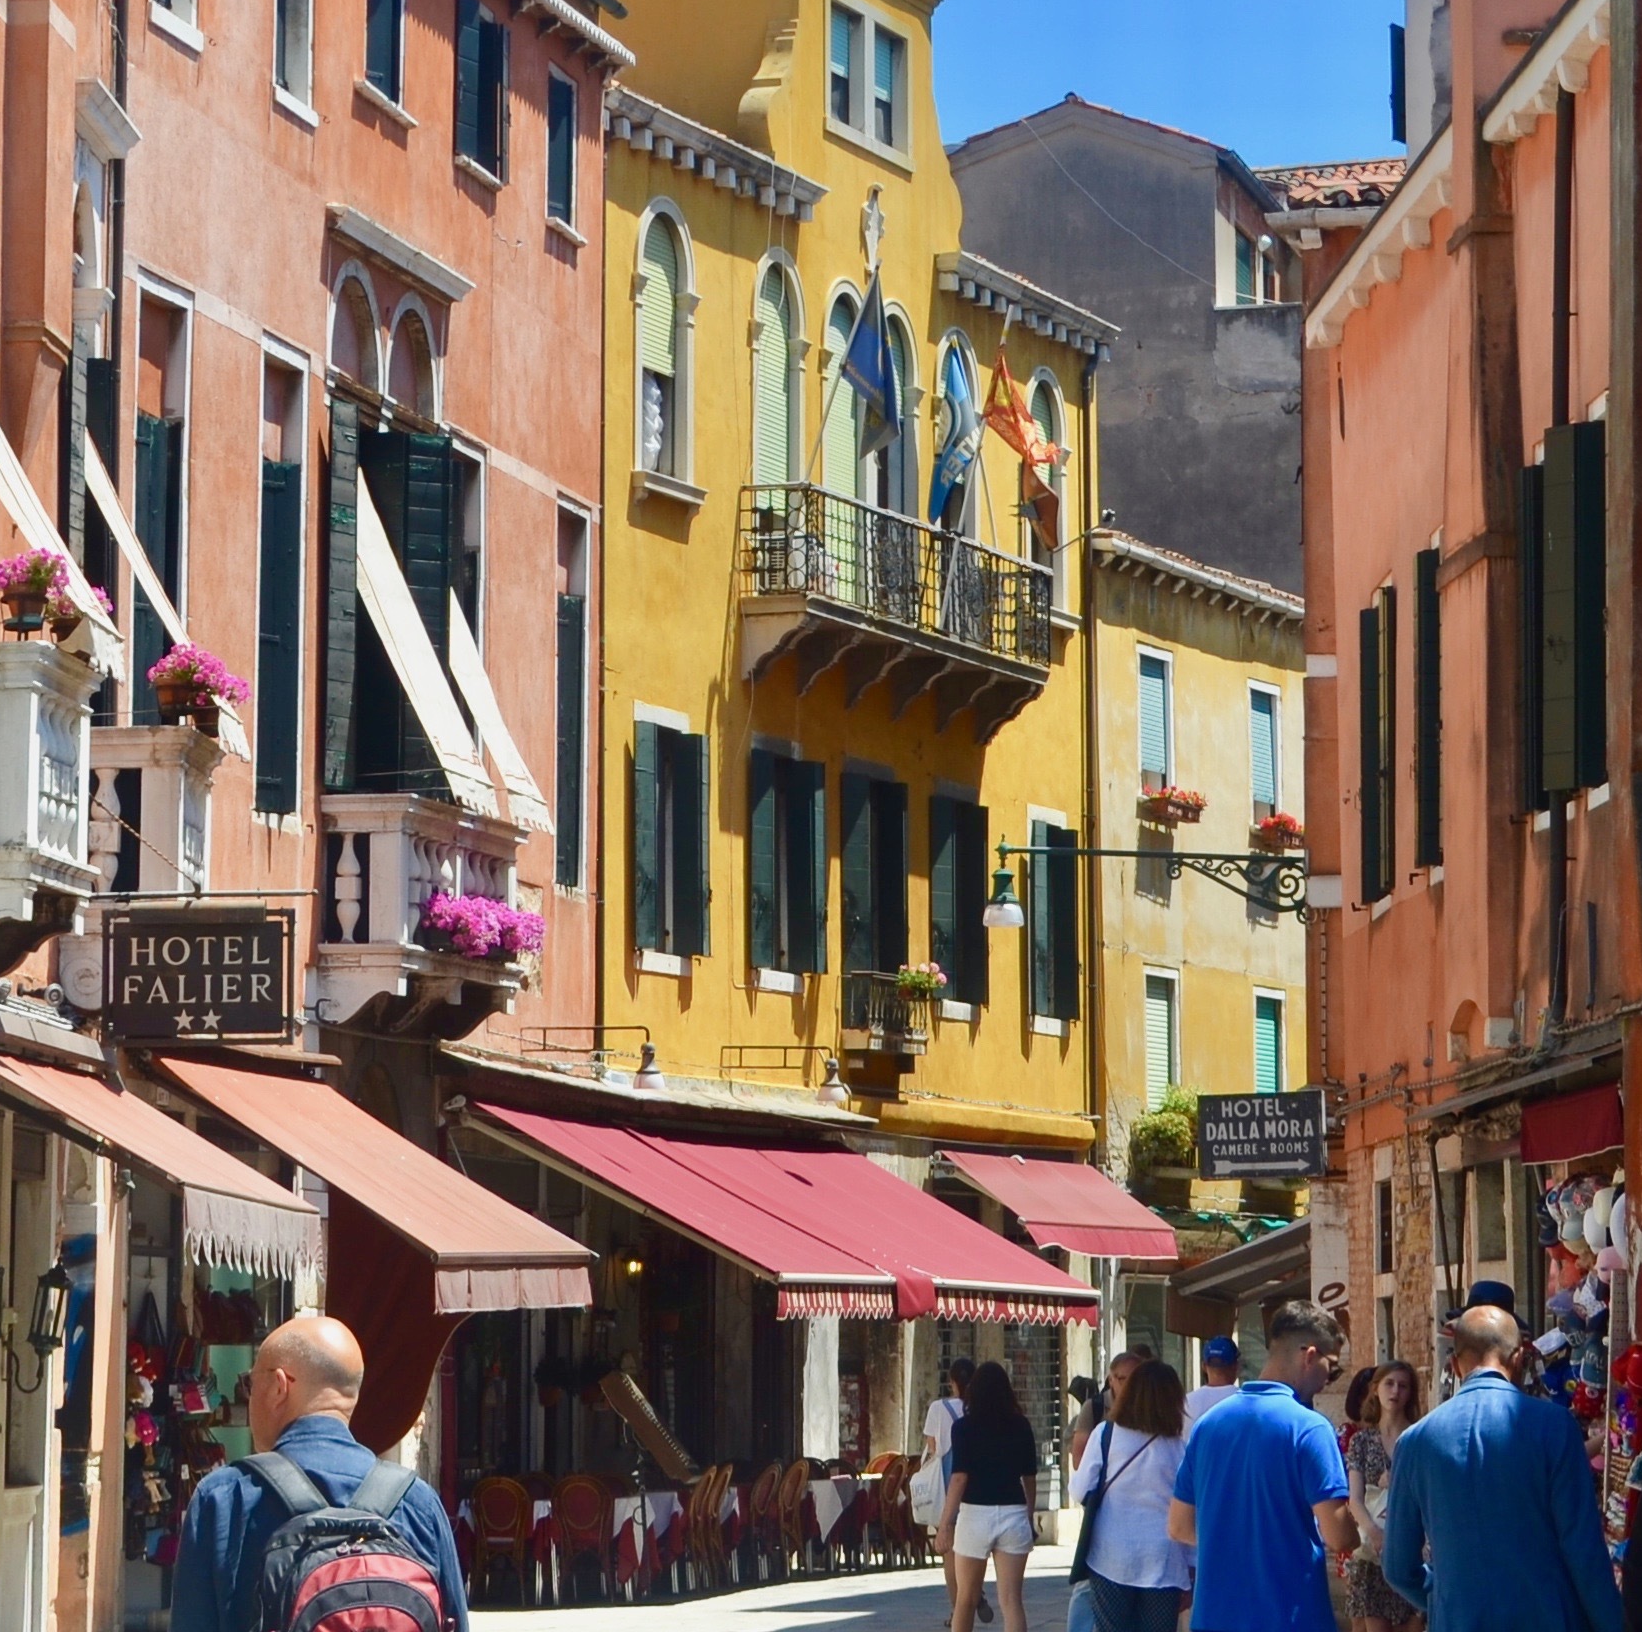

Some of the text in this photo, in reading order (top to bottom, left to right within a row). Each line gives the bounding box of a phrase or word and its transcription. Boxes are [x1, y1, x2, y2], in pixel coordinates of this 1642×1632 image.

[129, 935, 271, 967] HOTEL
[122, 973, 274, 1005] FALIER
[1220, 1098, 1285, 1119] HOTEL
[1205, 1118, 1314, 1142] DALLA MORA
[1212, 1143, 1258, 1156] CAMERE
[1270, 1141, 1310, 1154] ROOMS
[785, 1284, 843, 1308] TRATTORIA
[937, 1289, 1065, 1318] ANTICO GAFARO
